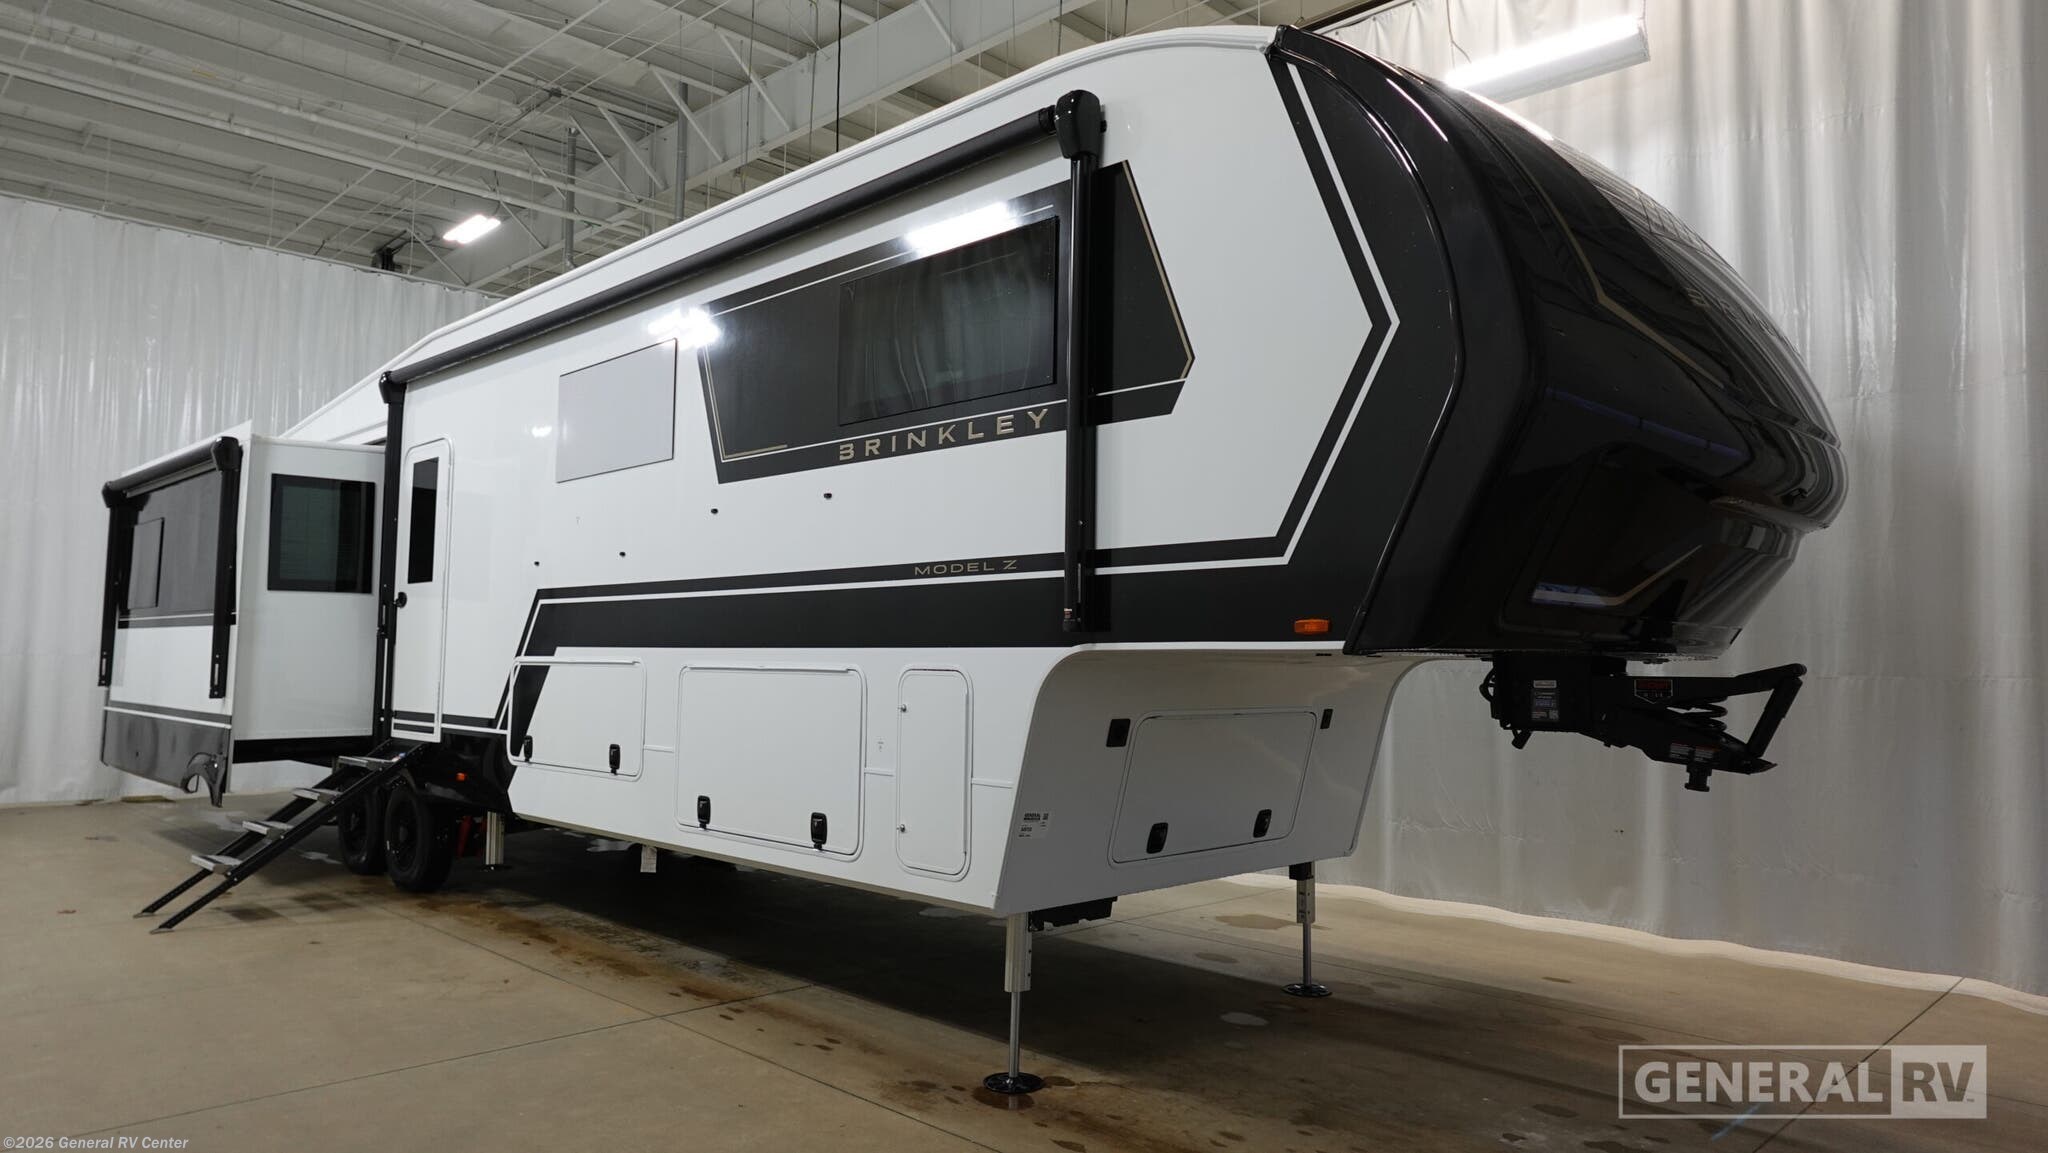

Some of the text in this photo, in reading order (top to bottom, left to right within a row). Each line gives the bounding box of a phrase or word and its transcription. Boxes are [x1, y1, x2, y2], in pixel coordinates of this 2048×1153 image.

[839, 408, 1049, 461] BRINKLEY
[914, 559, 1017, 576] MODEL Z
